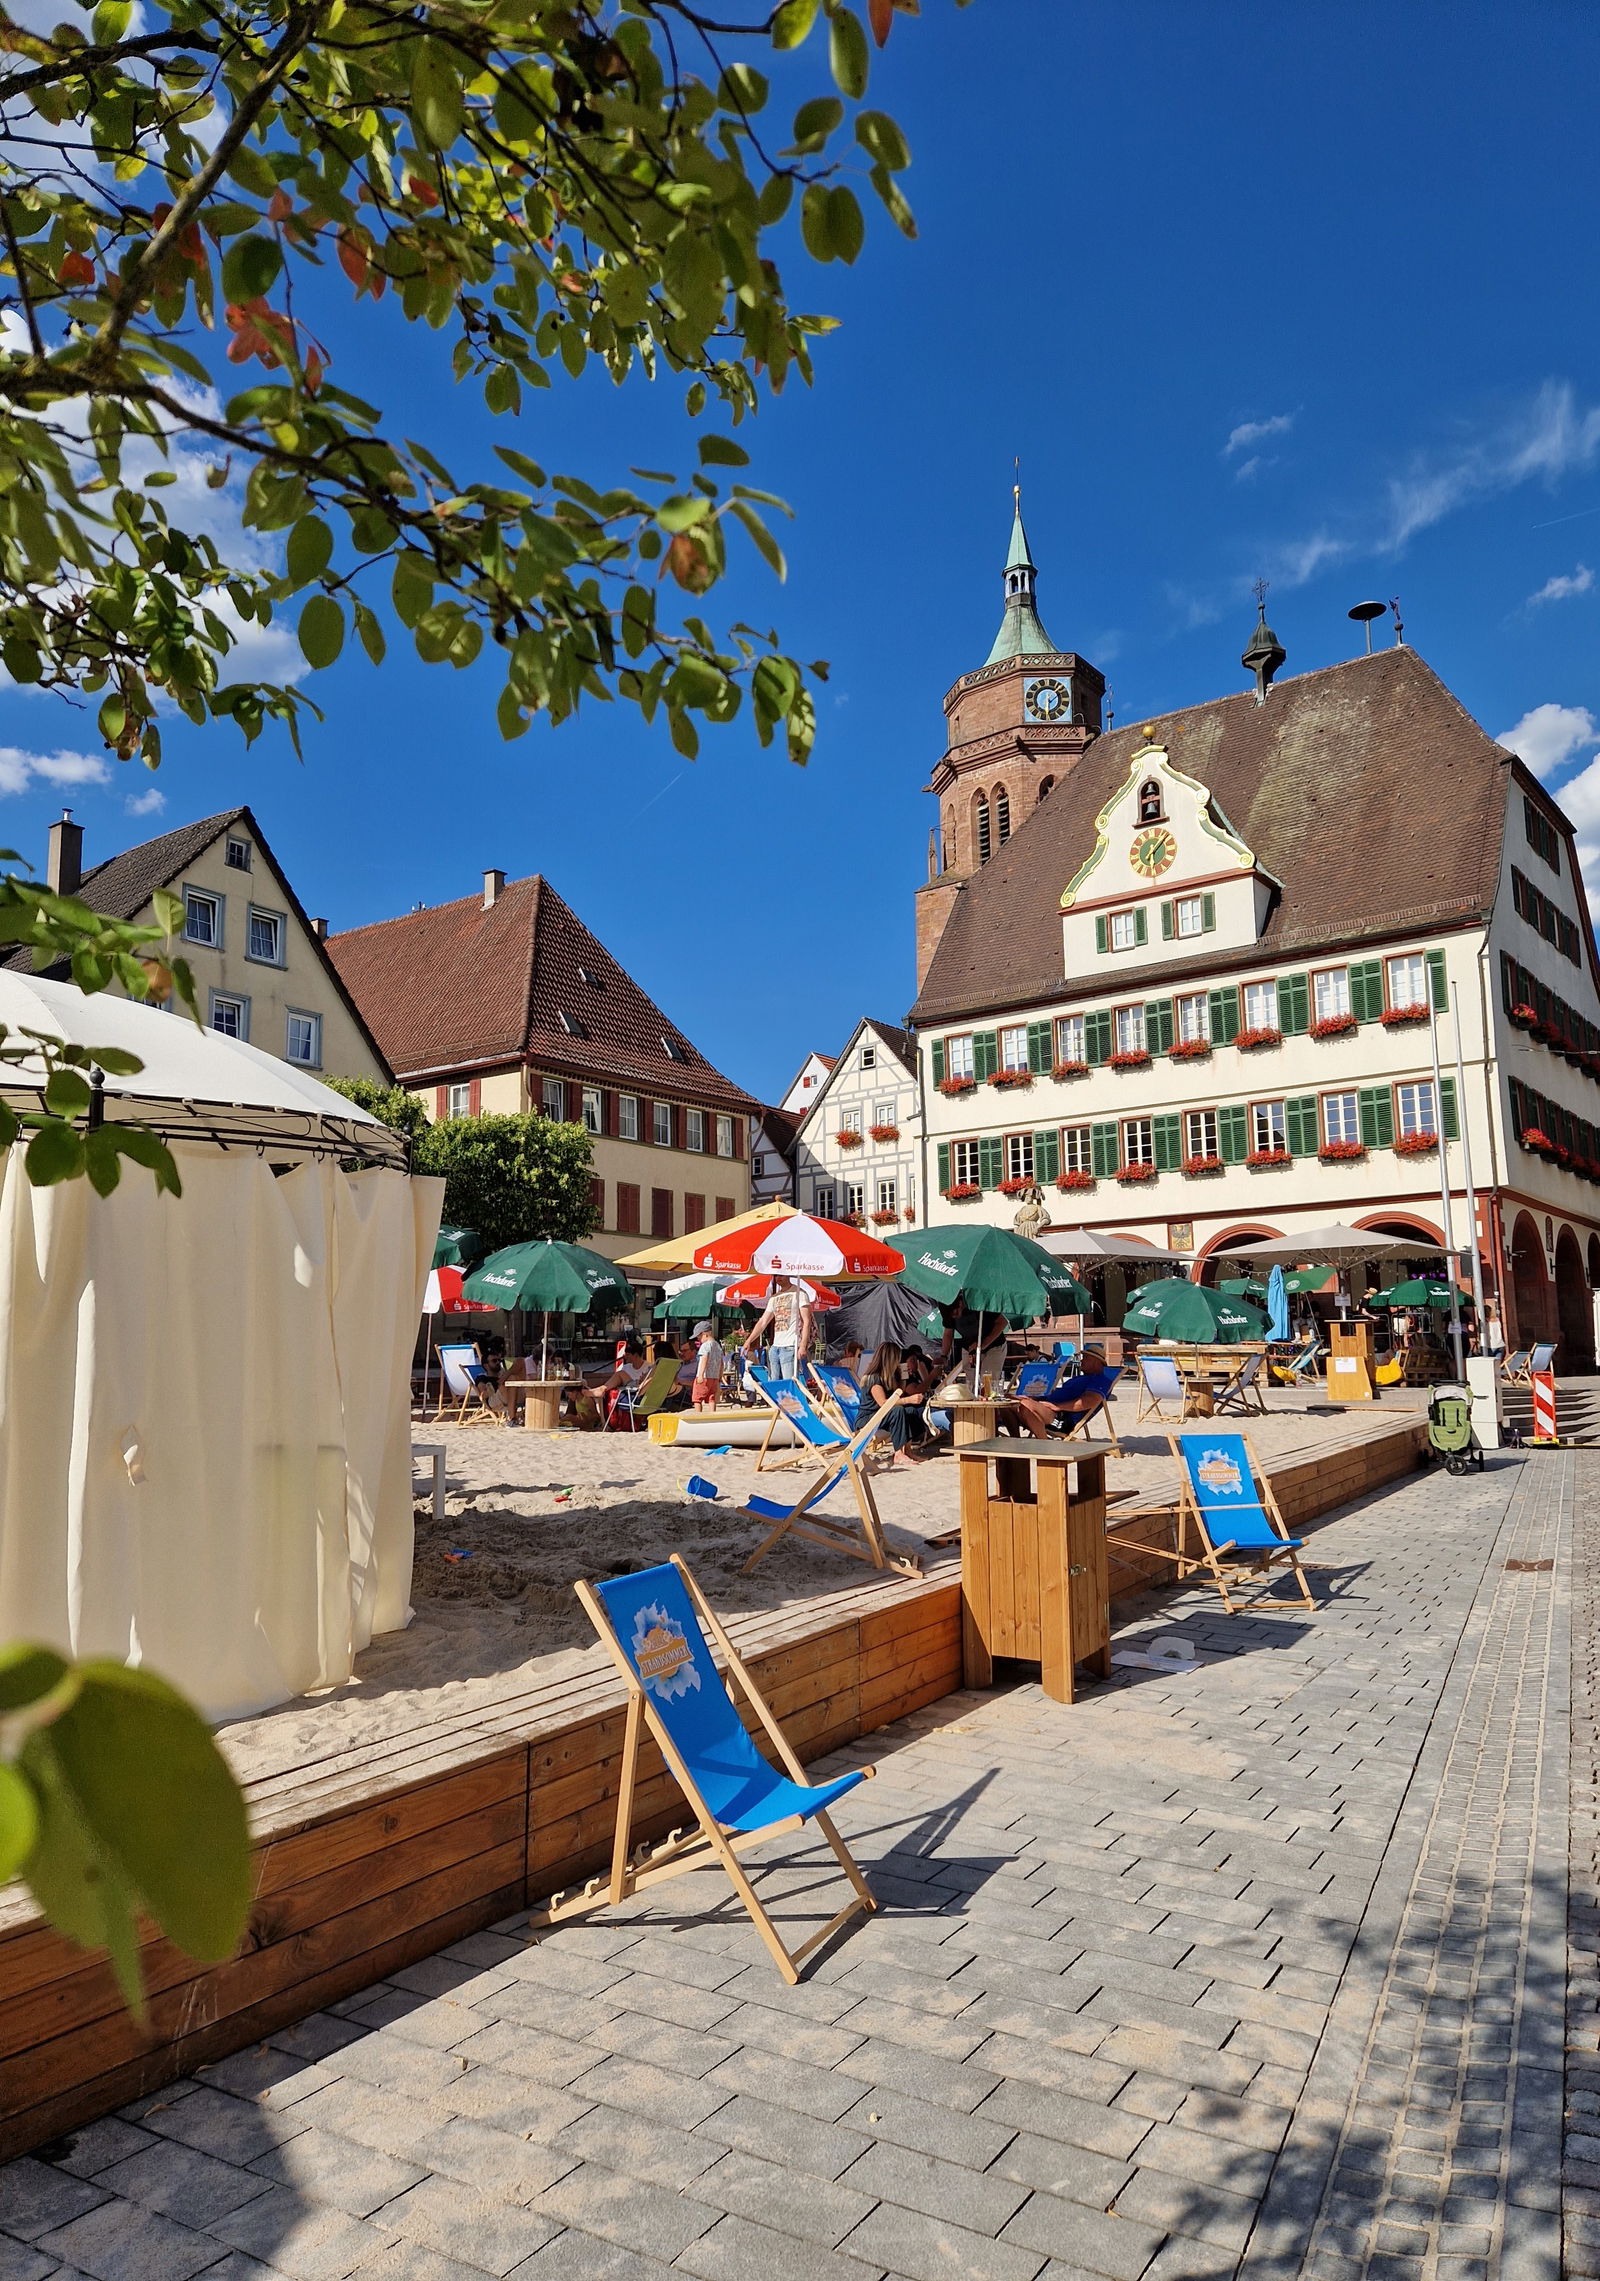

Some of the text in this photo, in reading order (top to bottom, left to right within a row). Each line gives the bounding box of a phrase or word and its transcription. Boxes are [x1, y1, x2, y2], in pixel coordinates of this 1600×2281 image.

[715, 1260, 742, 1269] Sparkasse
[785, 1262, 825, 1271] Sparkasse
[862, 1264, 889, 1272] Sparkasse
[640, 1645, 689, 1673] STRANDSOMMER
